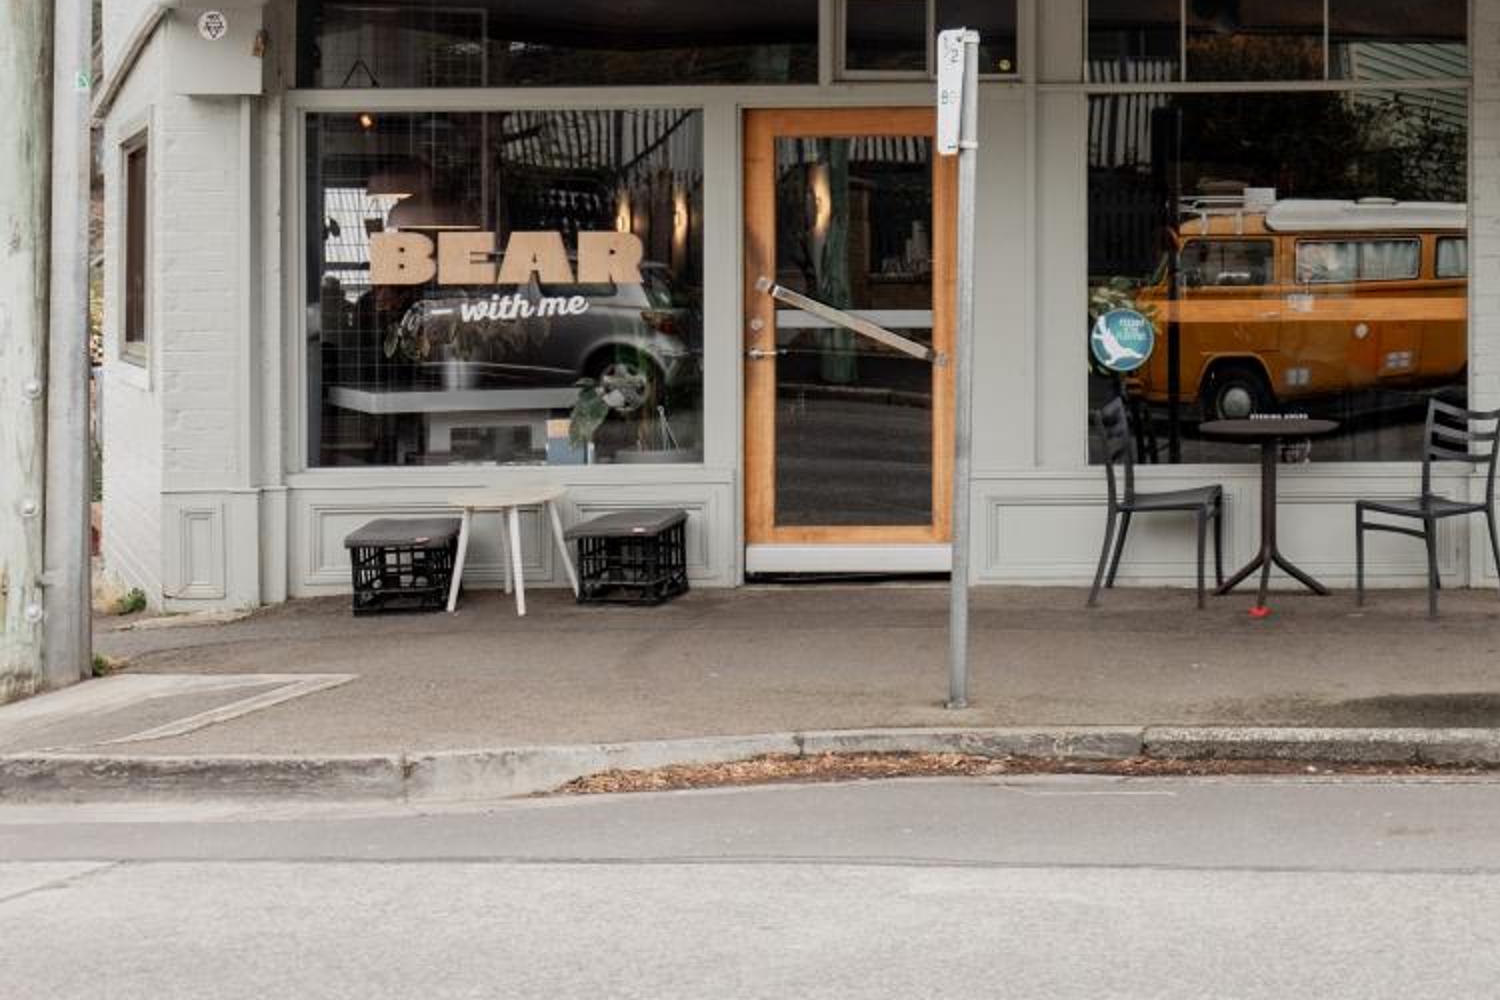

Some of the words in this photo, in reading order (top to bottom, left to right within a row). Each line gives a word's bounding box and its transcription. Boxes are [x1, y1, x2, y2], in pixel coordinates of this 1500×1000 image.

[369, 231, 644, 285] BEAR
[461, 294, 536, 322] with
[537, 293, 589, 317] me
